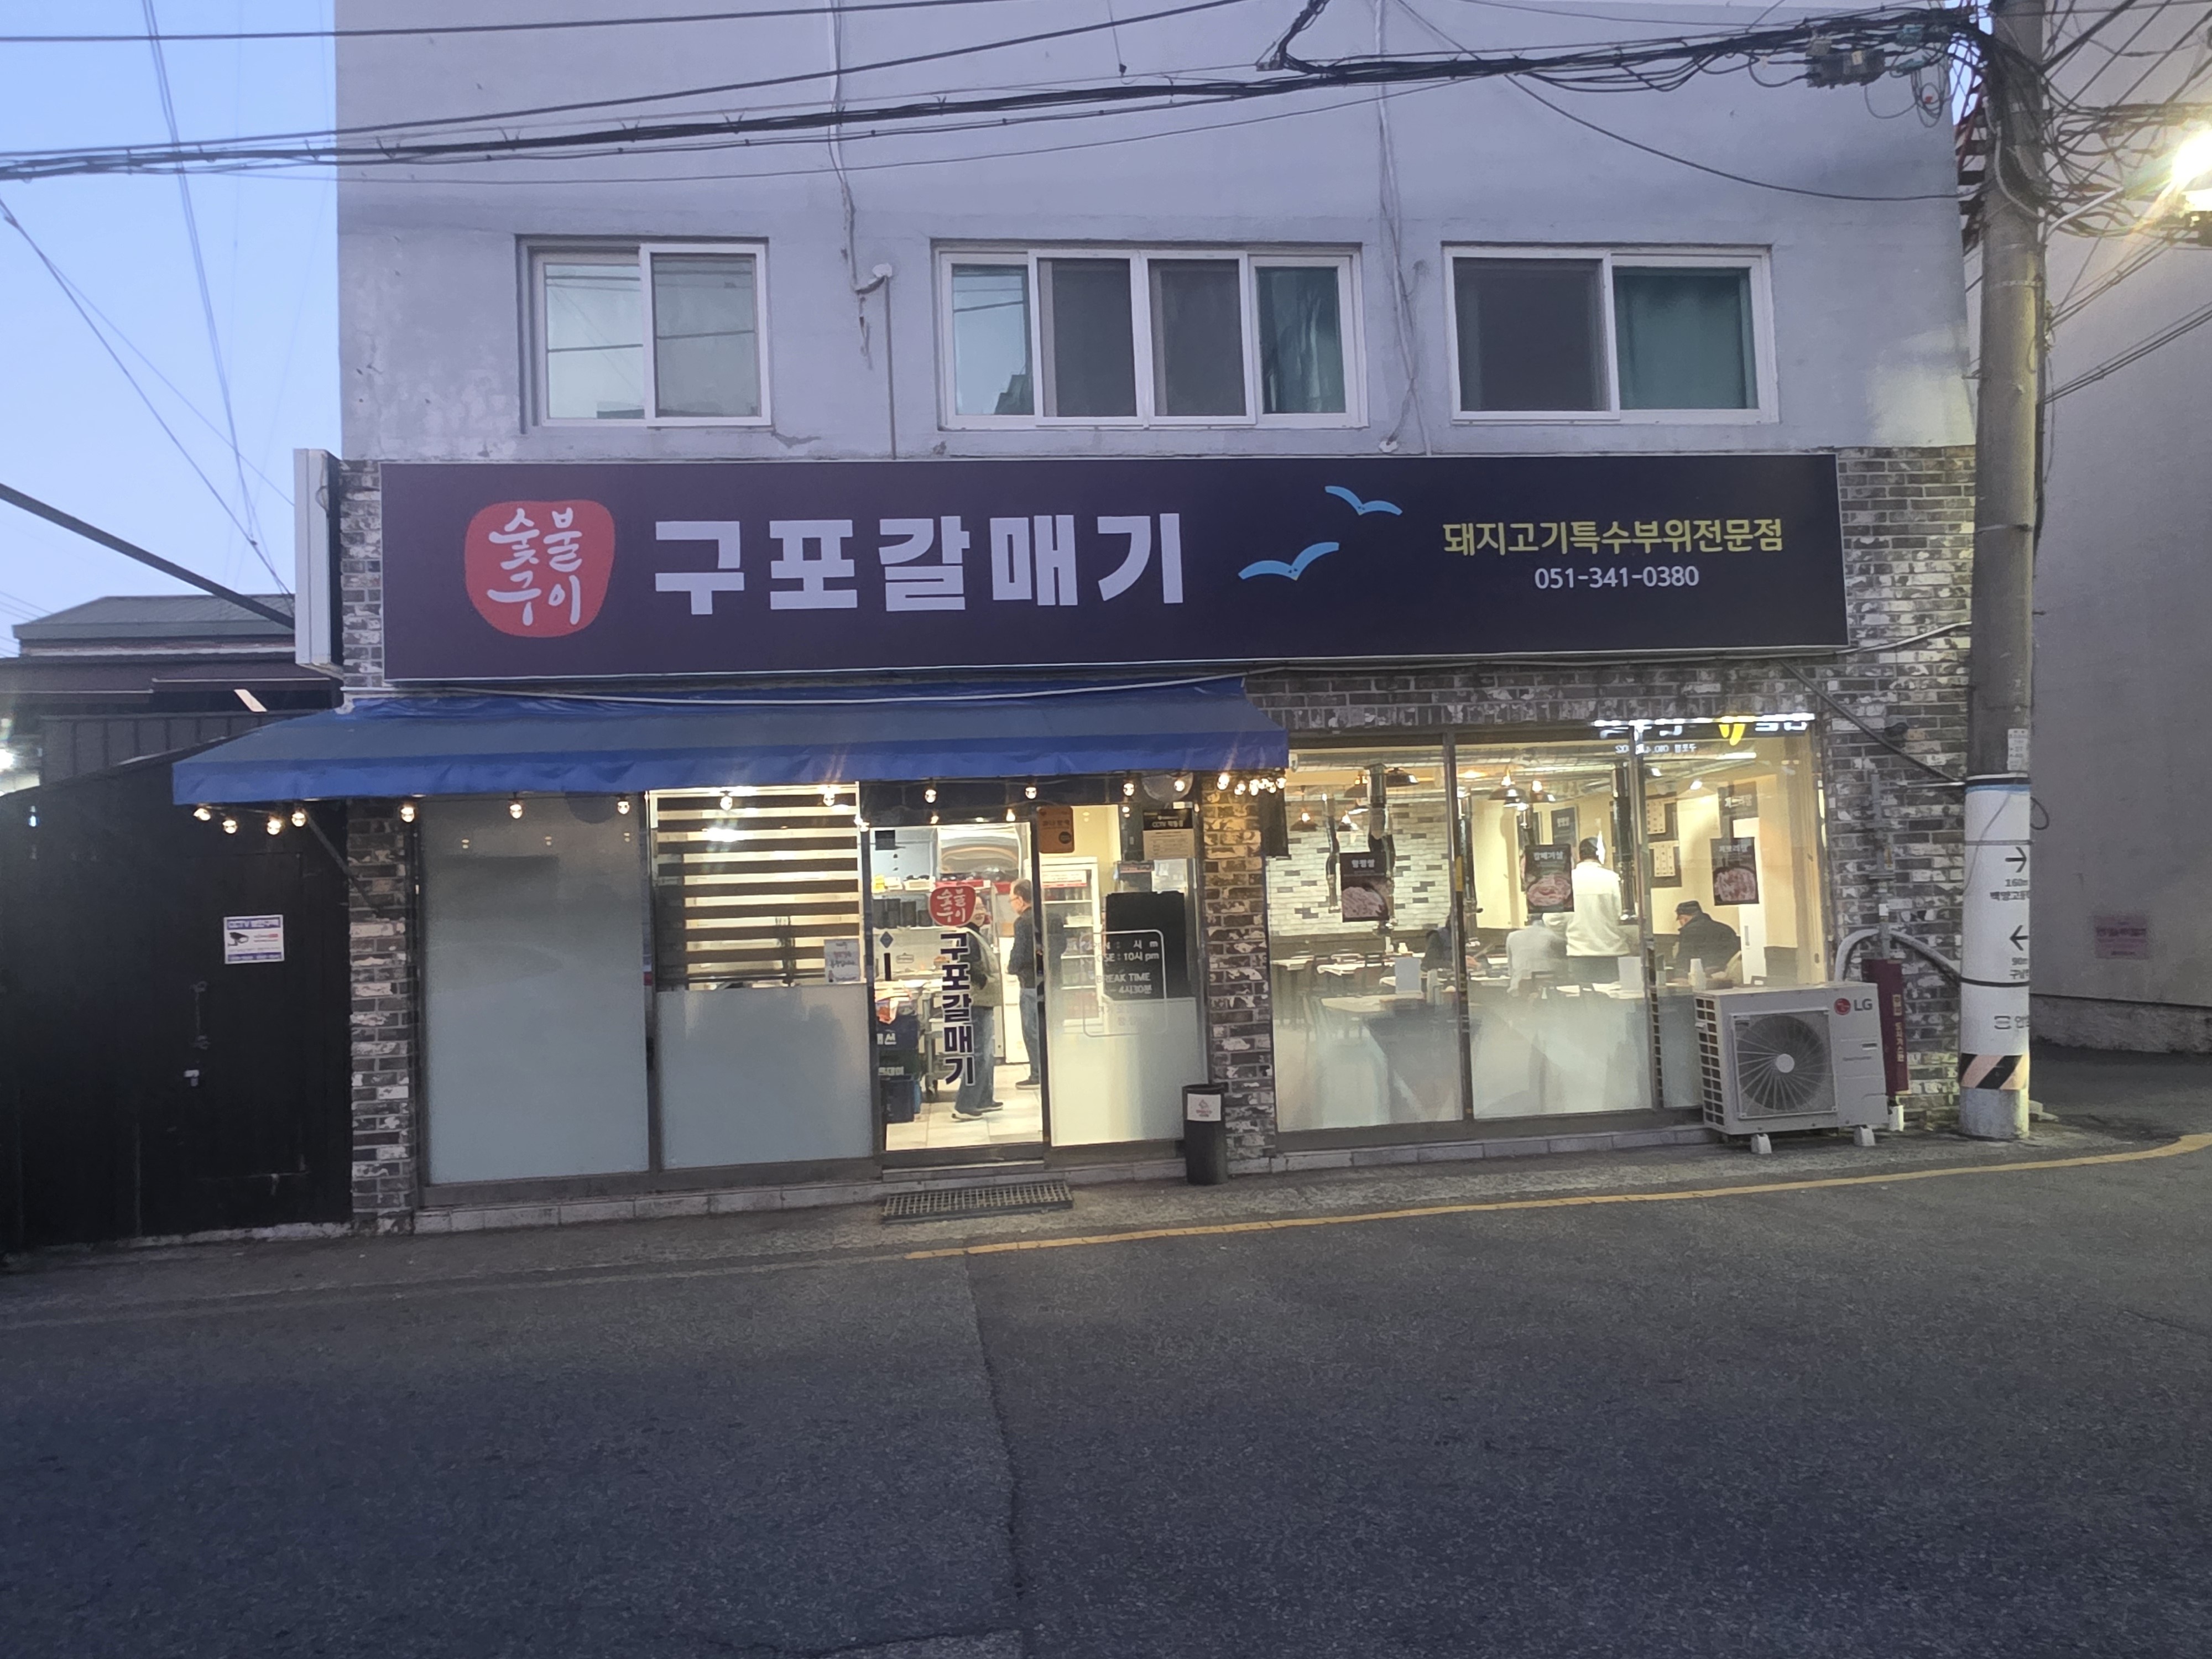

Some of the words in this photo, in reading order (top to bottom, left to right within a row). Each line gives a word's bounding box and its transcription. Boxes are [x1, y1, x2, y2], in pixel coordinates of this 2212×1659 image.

[488, 507, 583, 573] 숯불
[1442, 518, 1783, 555] 돼지고기특수부위전문점
[655, 512, 1183, 615] 구포갈매기
[1535, 565, 1699, 589] 051-341-0380
[487, 571, 581, 626] 구이
[937, 907, 966, 922] 구이
[1096, 974, 1126, 984] BREAK
[1128, 972, 1151, 982] TIME
[940, 932, 975, 1086] 구포갈매기
[1854, 998, 1873, 1011] LG
